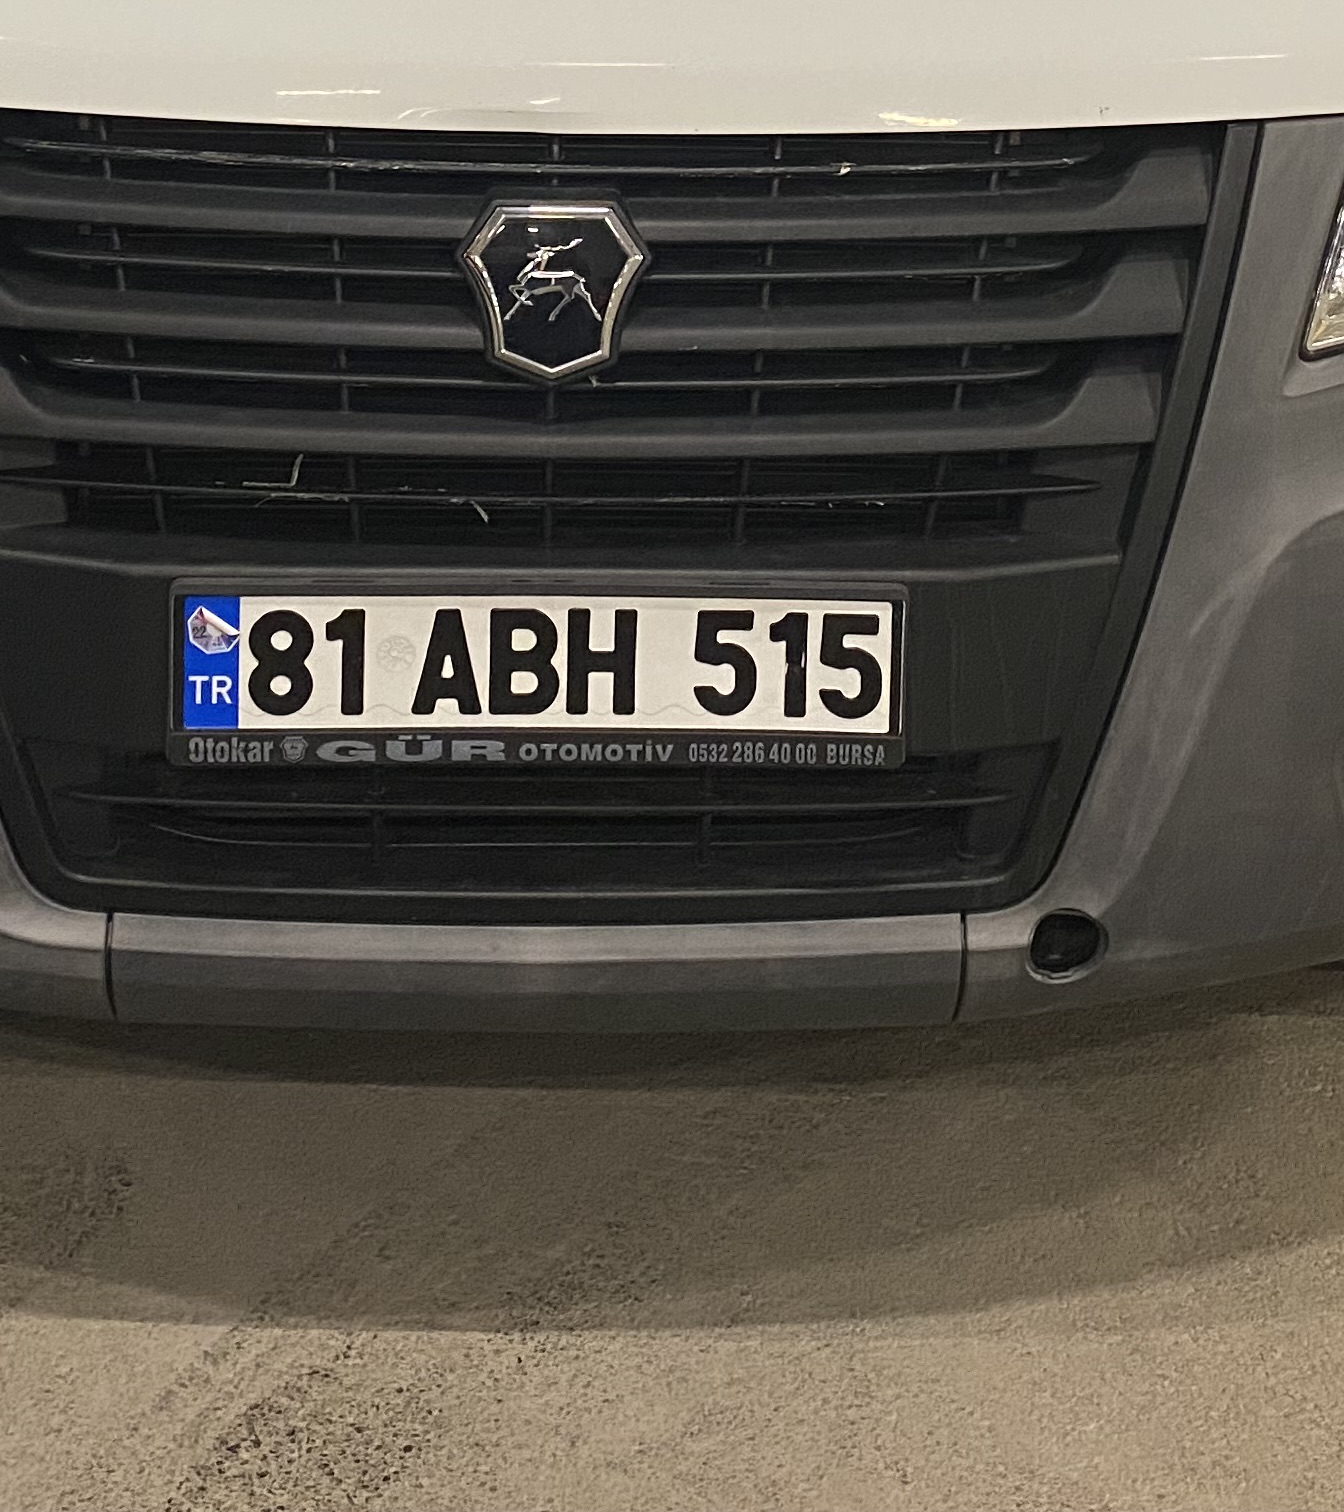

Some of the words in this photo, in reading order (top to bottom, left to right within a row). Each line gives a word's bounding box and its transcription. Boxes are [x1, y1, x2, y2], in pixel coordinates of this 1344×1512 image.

[248, 608, 366, 716] 81
[410, 608, 639, 716] ABH
[692, 609, 884, 719] 515
[188, 675, 233, 704] TR
[188, 737, 274, 763] Otokar
[316, 735, 506, 762] GÜR
[518, 740, 674, 763] OTOMOTİV
[688, 742, 729, 763] 0532
[732, 741, 765, 764] 286
[768, 742, 791, 764] 40
[794, 742, 817, 764] 00
[826, 742, 886, 766] BURSA
